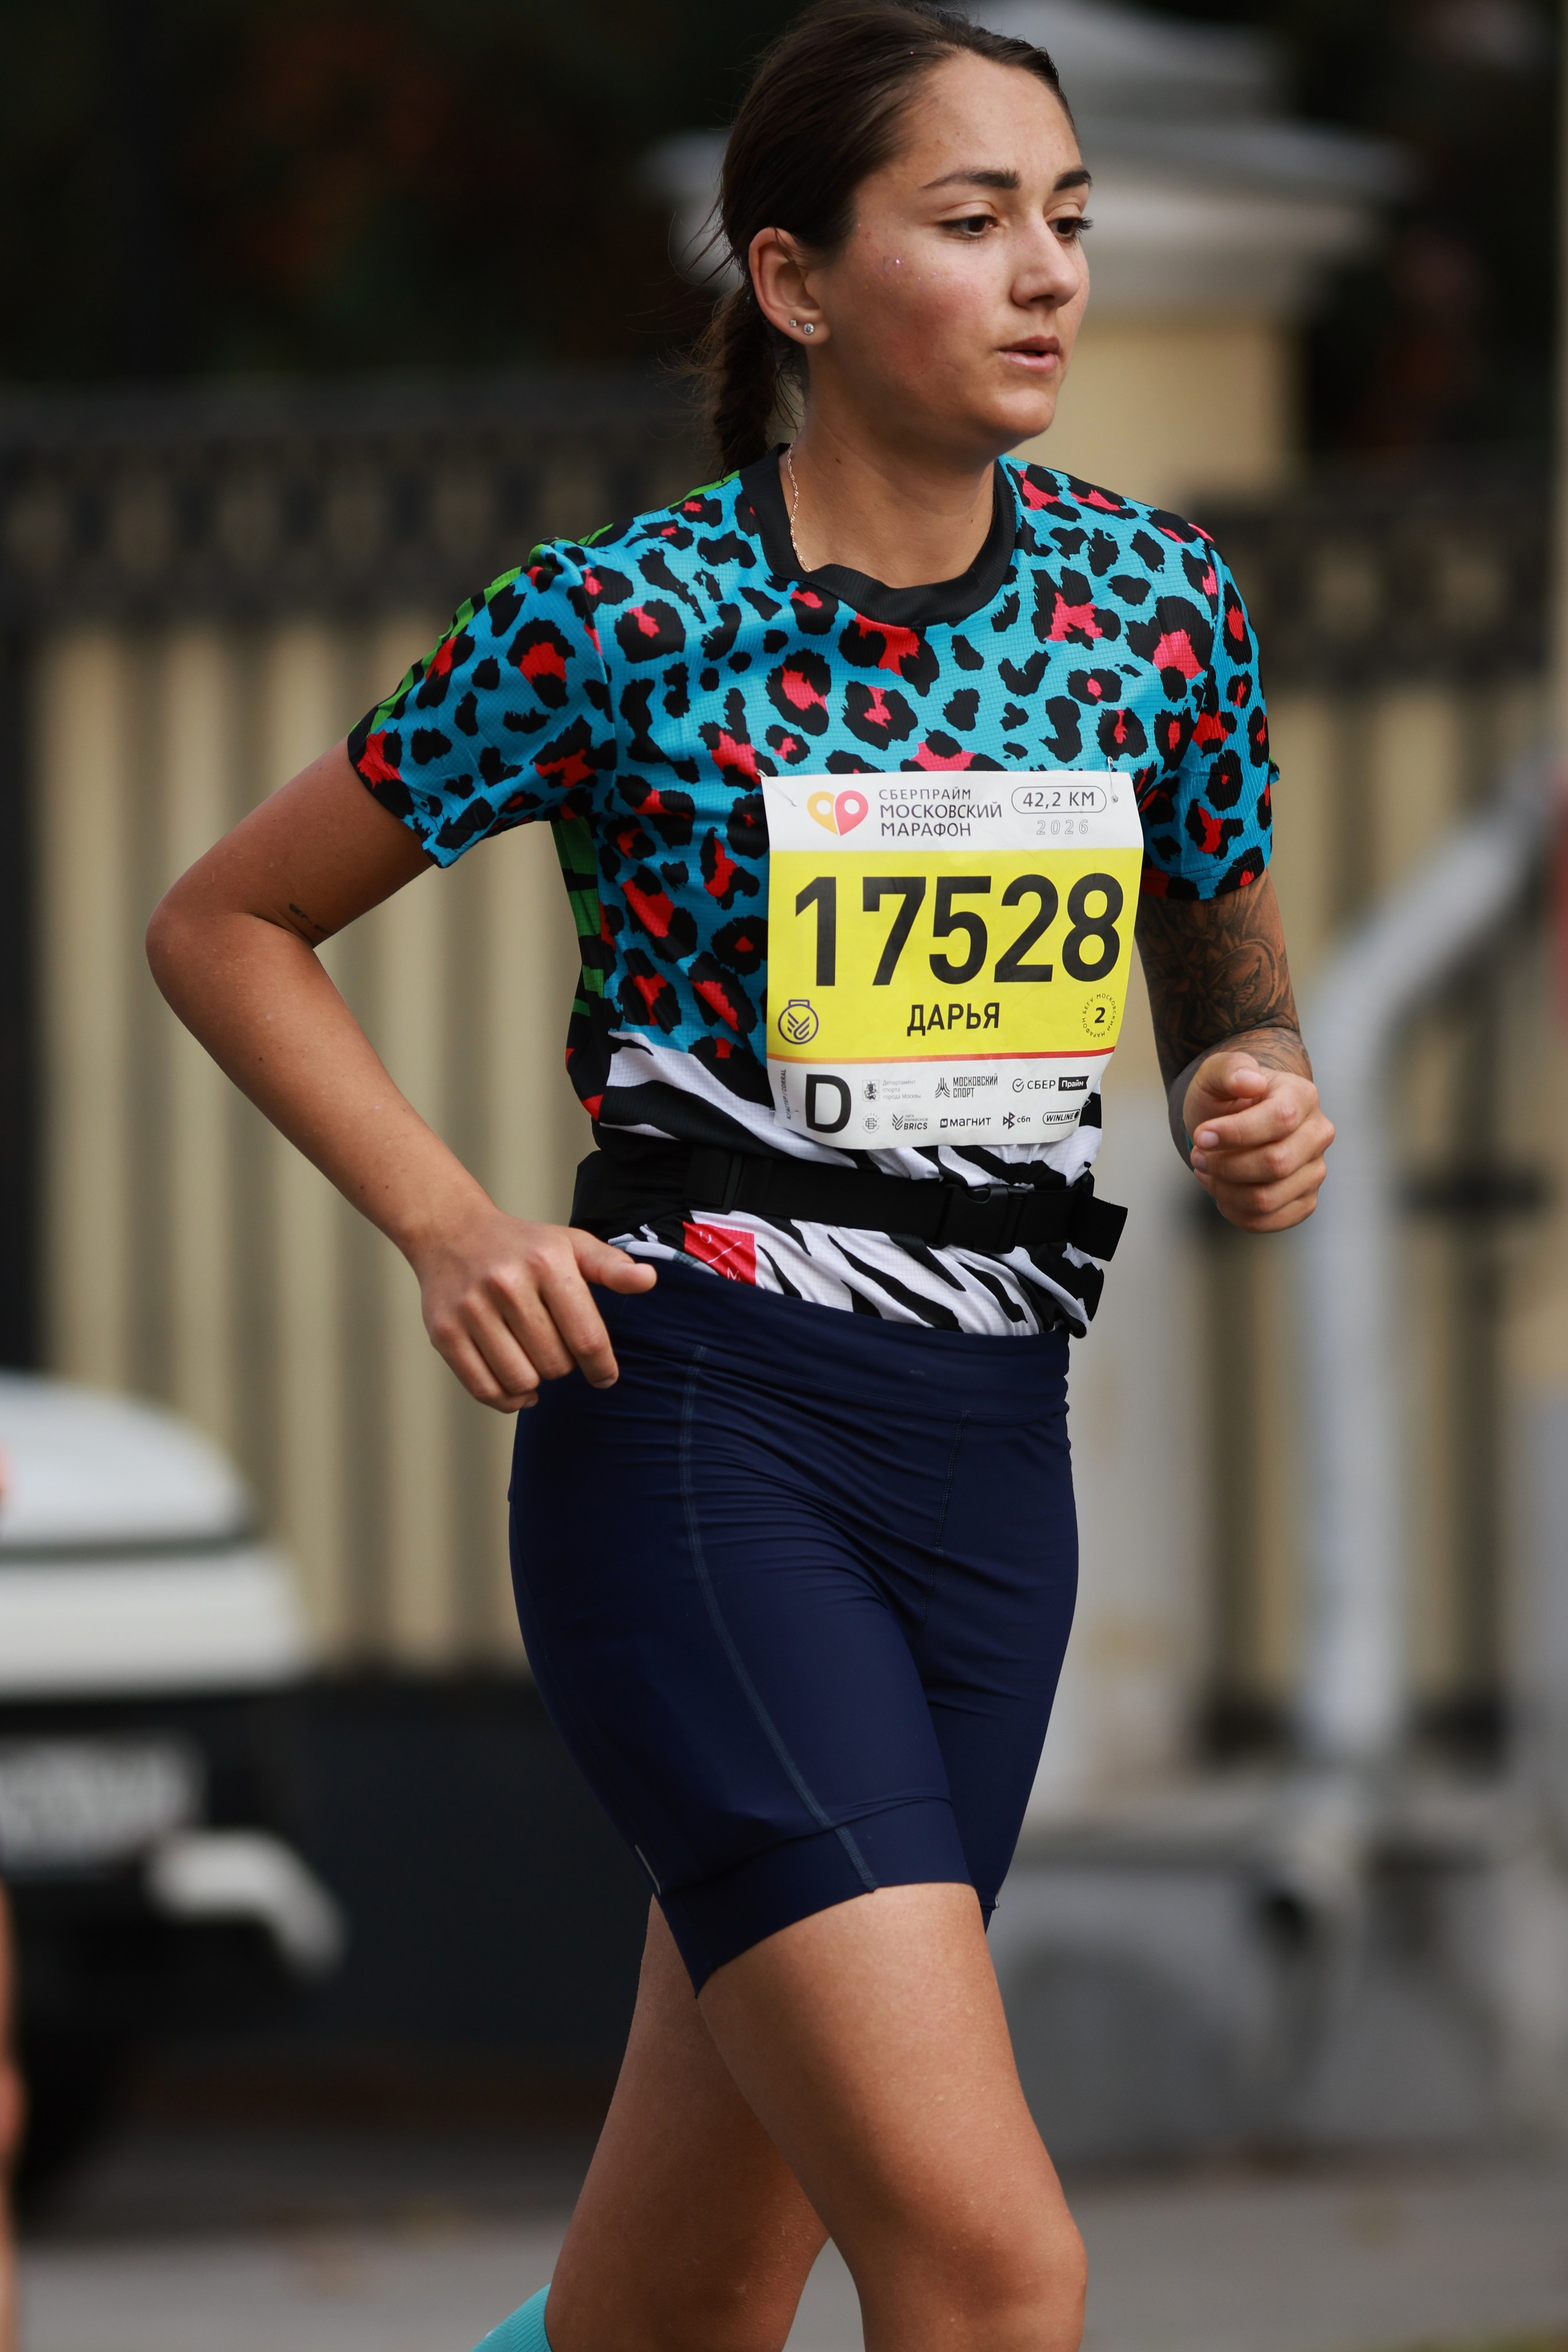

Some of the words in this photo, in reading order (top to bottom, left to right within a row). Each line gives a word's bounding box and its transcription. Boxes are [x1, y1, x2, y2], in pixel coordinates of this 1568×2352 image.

[879, 786, 971, 800] СБЕРПРАЙМ
[1022, 791, 1061, 810] 42,2
[1069, 791, 1095, 807] КМ
[880, 801, 1003, 819] МОСКОВСКИЙ
[881, 822, 971, 837] МАРАФОН
[1036, 819, 1089, 835] 2026
[795, 872, 1124, 987] 17528
[907, 1001, 1000, 1037] ДАРЬЯ
[1094, 1006, 1106, 1024] 2
[952, 1073, 998, 1087] МОСКОВСКИЙ
[1027, 1080, 1057, 1090] СБЕР
[1061, 1079, 1084, 1088] Прайм
[953, 1087, 974, 1098] СПОРТ
[805, 1073, 852, 1134] D
[1046, 1112, 1075, 1122] WINLINE
